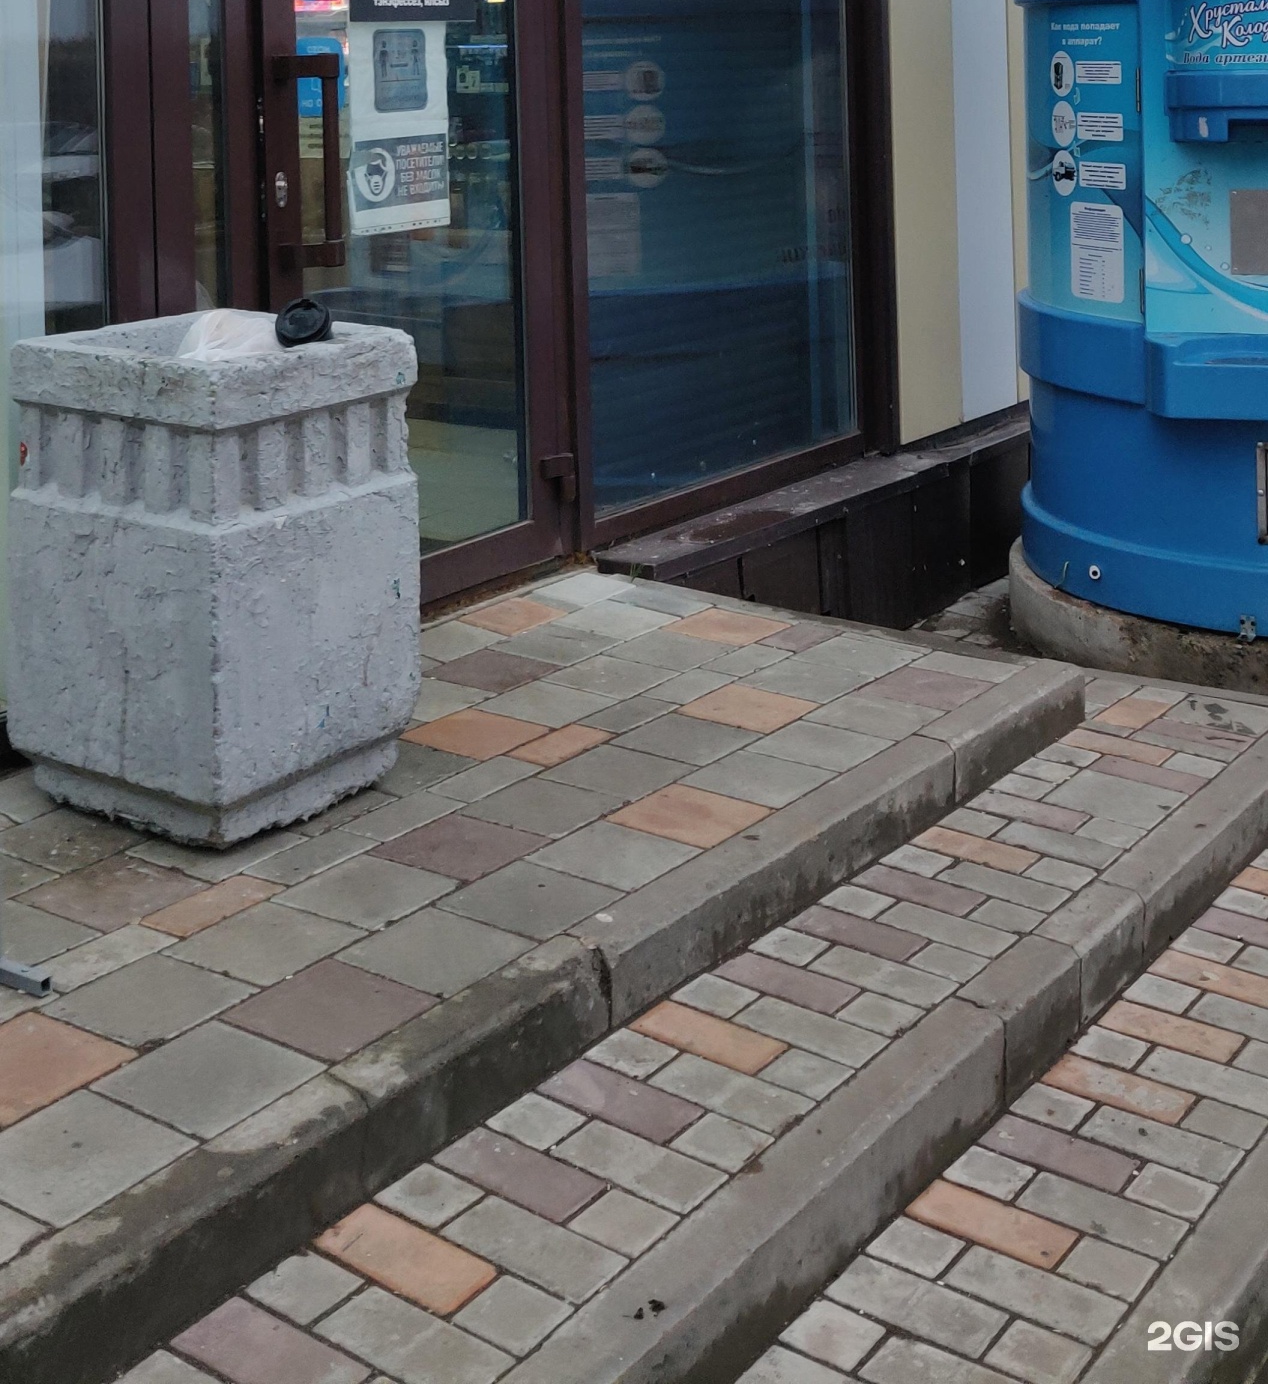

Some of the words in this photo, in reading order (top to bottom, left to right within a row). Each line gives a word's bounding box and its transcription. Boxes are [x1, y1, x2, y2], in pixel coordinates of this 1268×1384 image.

[1080, 22, 1120, 31] попадает
[1188, 0, 1268, 43] Хрустал
[1221, 15, 1268, 49] Колод
[1067, 36, 1102, 47] аппарат?
[1183, 52, 1210, 64] Вода
[1215, 54, 1268, 66] артези
[397, 141, 444, 157] УВАЖАЕМЫЕ
[401, 171, 414, 183] БЕЗ
[398, 185, 408, 196] НЕ
